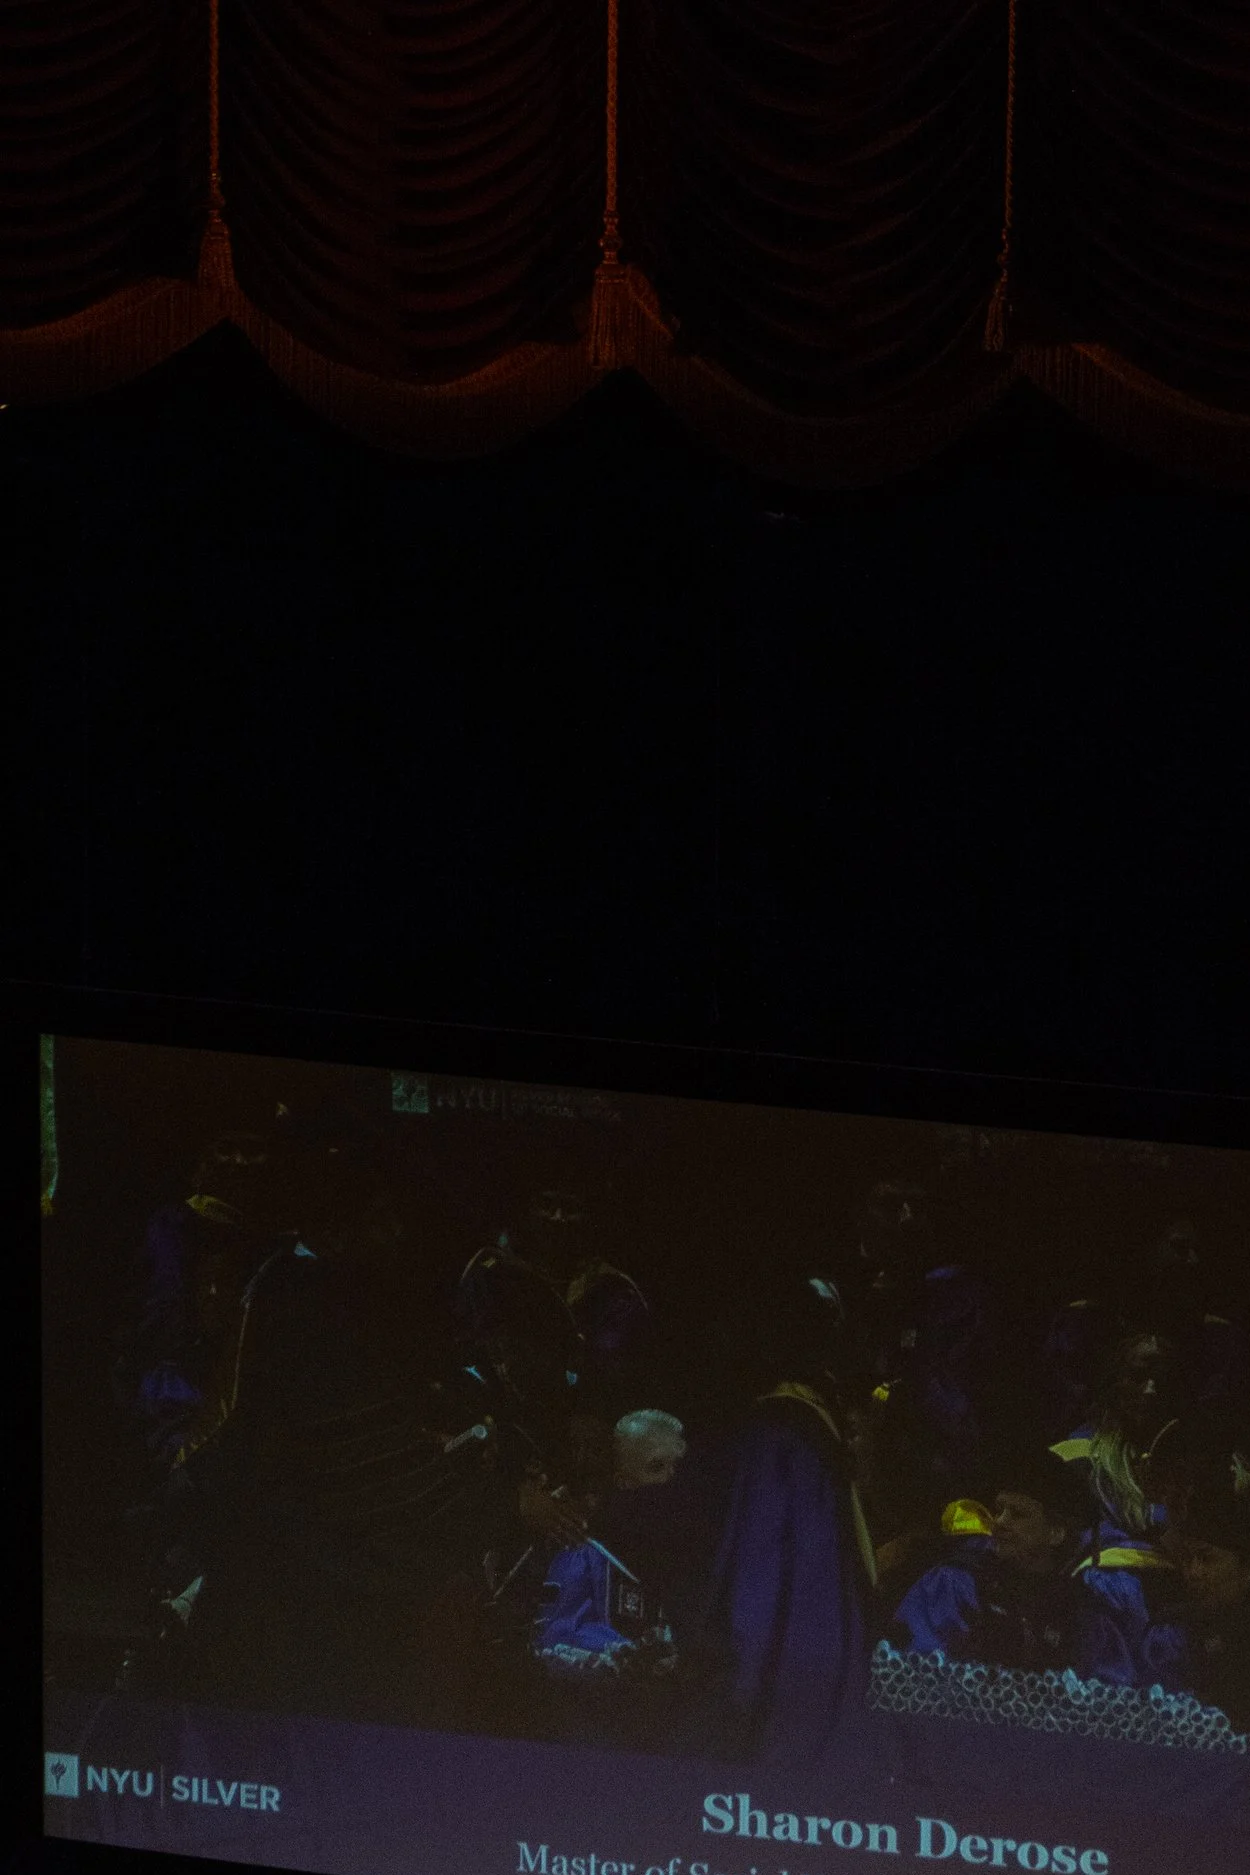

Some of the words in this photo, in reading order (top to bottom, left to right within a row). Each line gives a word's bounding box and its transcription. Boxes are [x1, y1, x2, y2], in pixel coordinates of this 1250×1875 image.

[87, 1765, 155, 1797] NYU
[171, 1775, 281, 1812] SILVER
[702, 1792, 900, 1854] Sharon
